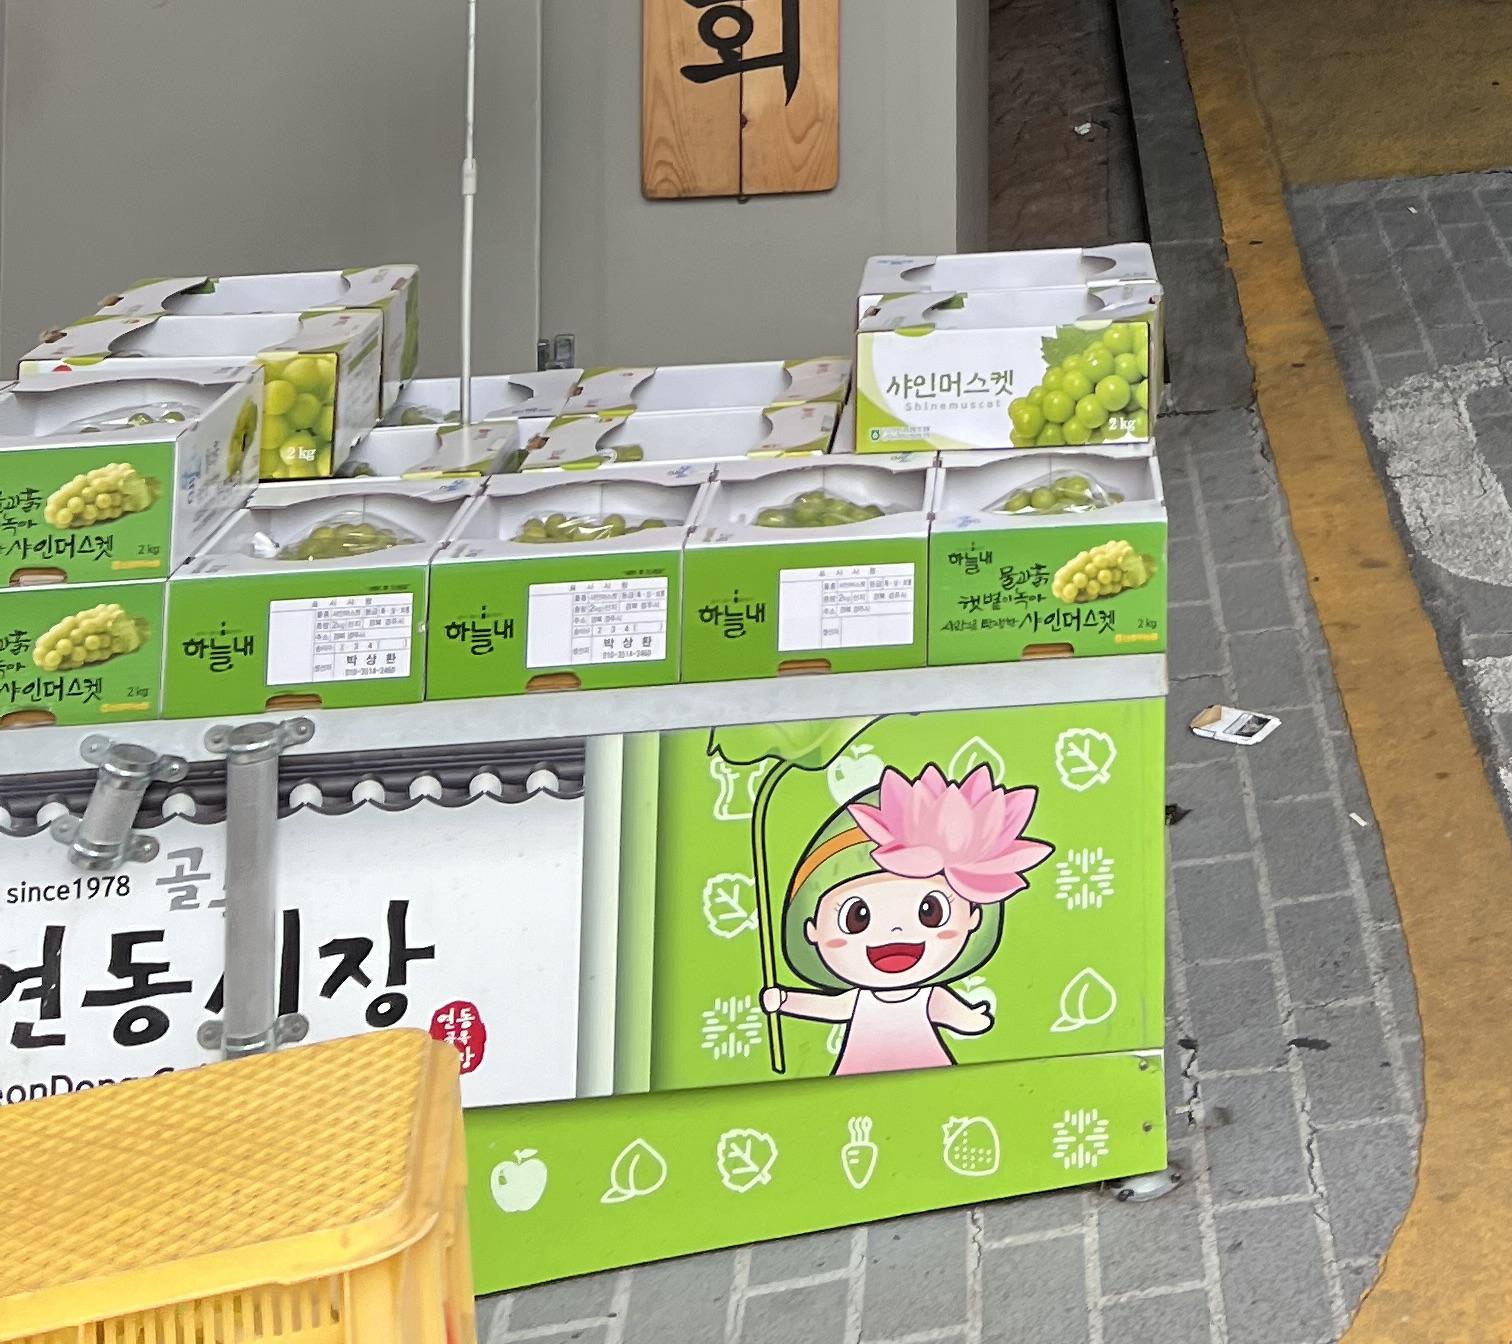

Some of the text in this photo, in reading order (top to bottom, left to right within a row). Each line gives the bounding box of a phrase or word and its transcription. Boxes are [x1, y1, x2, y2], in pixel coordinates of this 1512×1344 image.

[886, 369, 1015, 401] 샤인머스켓
[904, 399, 1001, 413] Shinemuscat
[0, 487, 42, 511] 과흙
[947, 548, 993, 575] 하늘내
[445, 616, 515, 655] 하늘내
[698, 601, 767, 640] 하늘내
[1018, 609, 1115, 633] 샤인머스켓
[183, 634, 254, 673] 하늘내
[6, 874, 132, 906] since1978
[155, 846, 226, 912] 골
[437, 1007, 476, 1029] 연동
